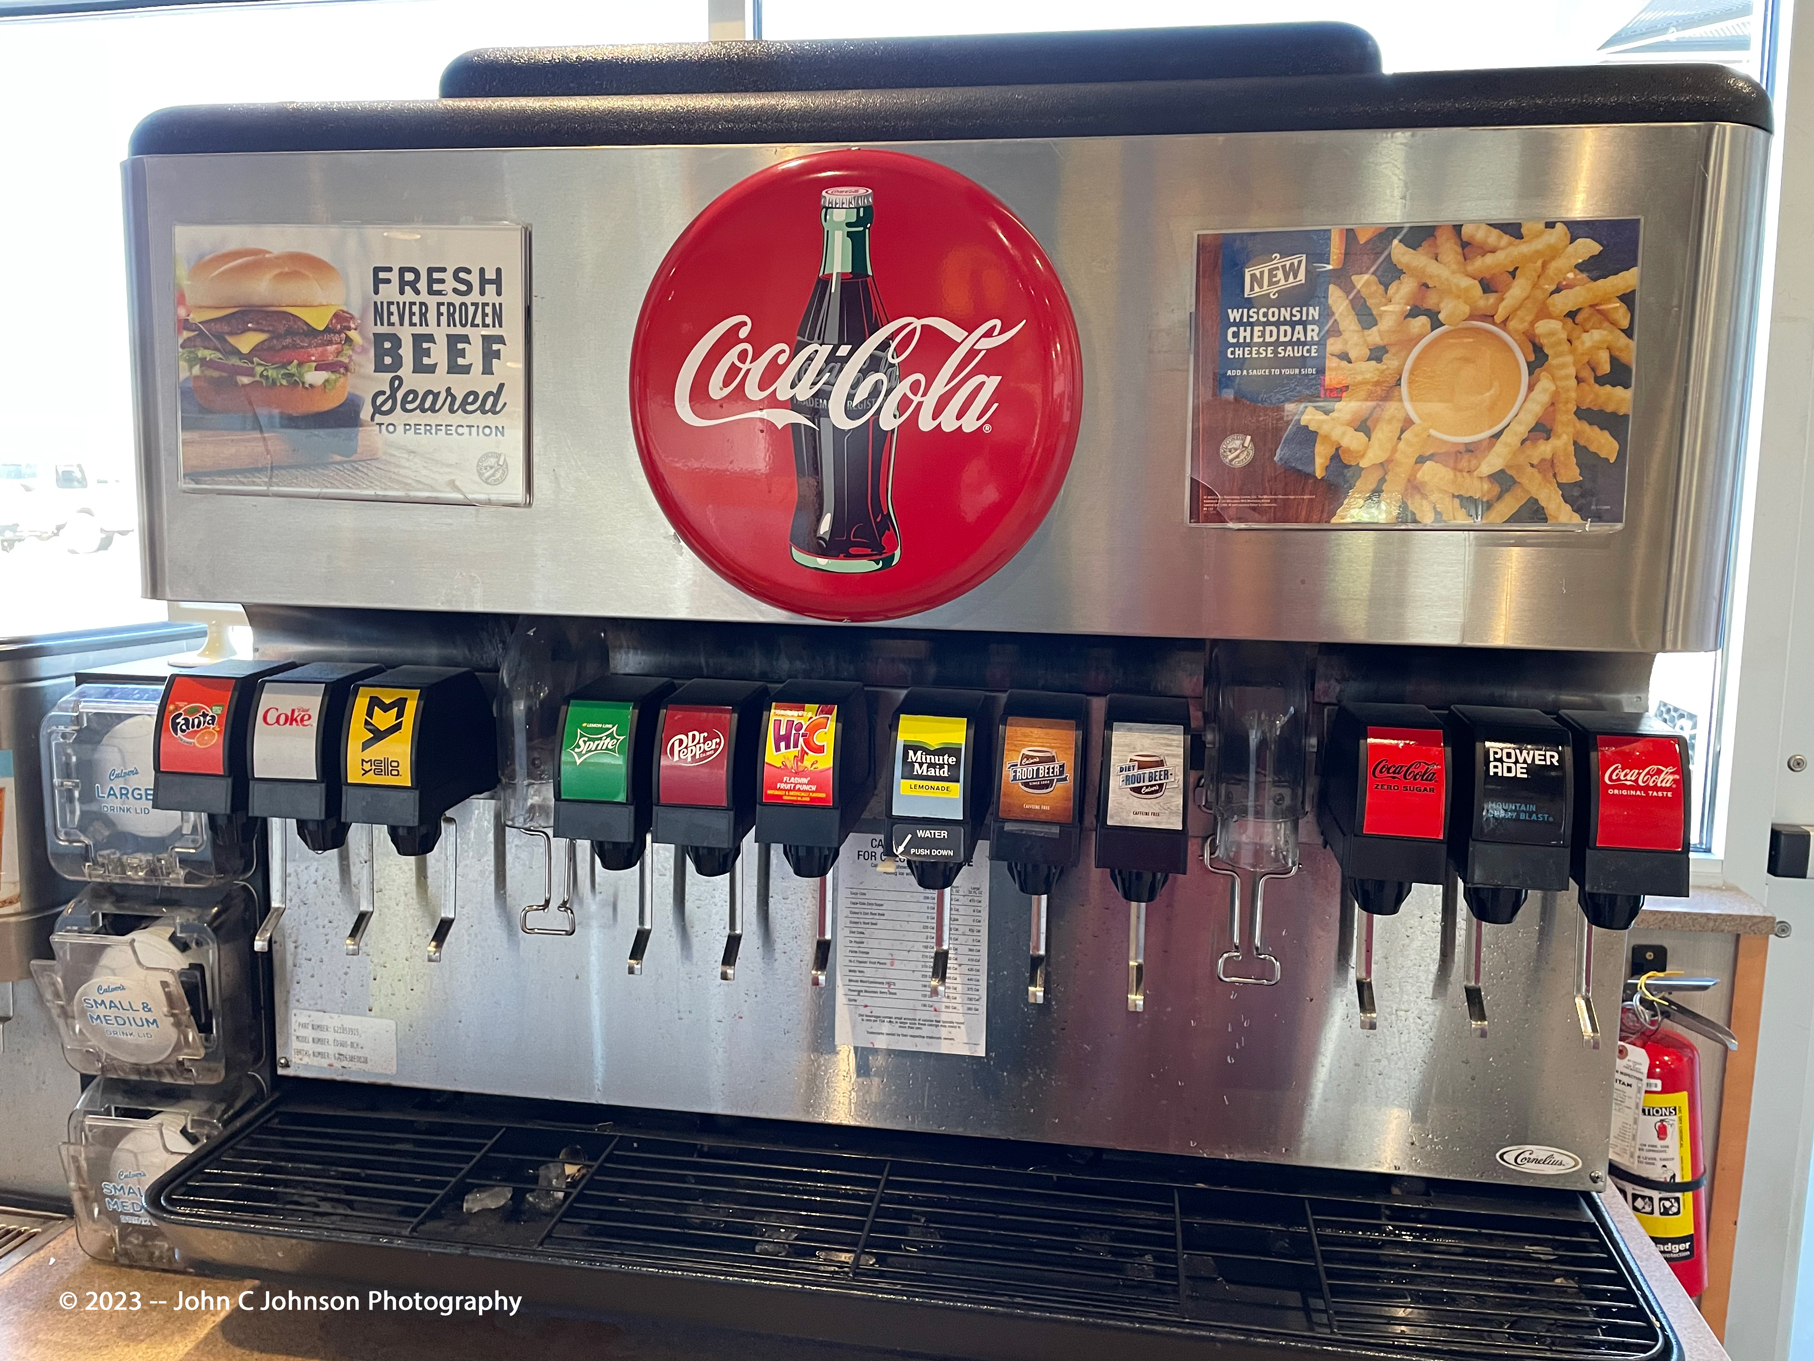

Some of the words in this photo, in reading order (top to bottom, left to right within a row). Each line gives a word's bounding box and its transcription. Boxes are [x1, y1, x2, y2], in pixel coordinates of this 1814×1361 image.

[372, 266, 503, 297] FRESH
[1248, 259, 1303, 293] NEW
[373, 301, 429, 327] NEVER
[436, 302, 503, 328] FROZEN
[1227, 306, 1320, 322] WISCONSIN
[1227, 325, 1320, 343] CHEDDAR
[372, 332, 507, 375] BEEF
[1227, 346, 1275, 358] CHEESE
[1277, 345, 1318, 357] SAUCE
[674, 314, 1027, 434] Coca-Cola
[1300, 367, 1317, 375] SIDE
[370, 374, 507, 422] Seared
[375, 423, 397, 434] TO
[403, 423, 505, 437] PERFECTION
[170, 711, 217, 737] Fanta
[262, 706, 312, 727] Coke
[687, 730, 708, 746] Dr
[772, 715, 831, 755] Hi-C
[574, 735, 618, 755] Sprite
[673, 734, 720, 762] Pepper
[907, 750, 957, 765] Minute
[1489, 747, 1559, 766] POWER
[912, 762, 949, 777] Maid
[1016, 766, 1038, 780] ROOT
[1039, 764, 1060, 778] BEER
[1119, 764, 1136, 773] DIET
[1372, 758, 1441, 783] Coca-Cola
[1489, 762, 1528, 778] ADE
[1604, 763, 1678, 788] Coca-Cola
[1125, 772, 1147, 786] ROOT
[1147, 769, 1169, 783] BEER
[95, 784, 154, 801] LARGE
[795, 783, 817, 791] PUNCH
[909, 784, 950, 792] LEMONADE
[1373, 783, 1400, 791] ZERO
[1402, 785, 1436, 793] SUGAR
[1608, 788, 1646, 797] ORIGINAL
[102, 804, 132, 814] DRINK
[134, 806, 150, 815] LID
[1519, 812, 1549, 821] BLAST
[916, 829, 948, 839] WATER
[857, 850, 877, 861] FOR
[910, 848, 931, 856] PUSH
[931, 849, 954, 857] DOWN
[83, 997, 140, 1012] SMALL
[141, 1001, 153, 1013] &
[88, 1013, 160, 1029] MEDIUM
[105, 1029, 135, 1038] DRINK
[137, 1031, 153, 1039] LID
[1513, 1149, 1564, 1167] Cornelius
[1656, 1242, 1691, 1253] adger
[1662, 1250, 1691, 1258] rotection
